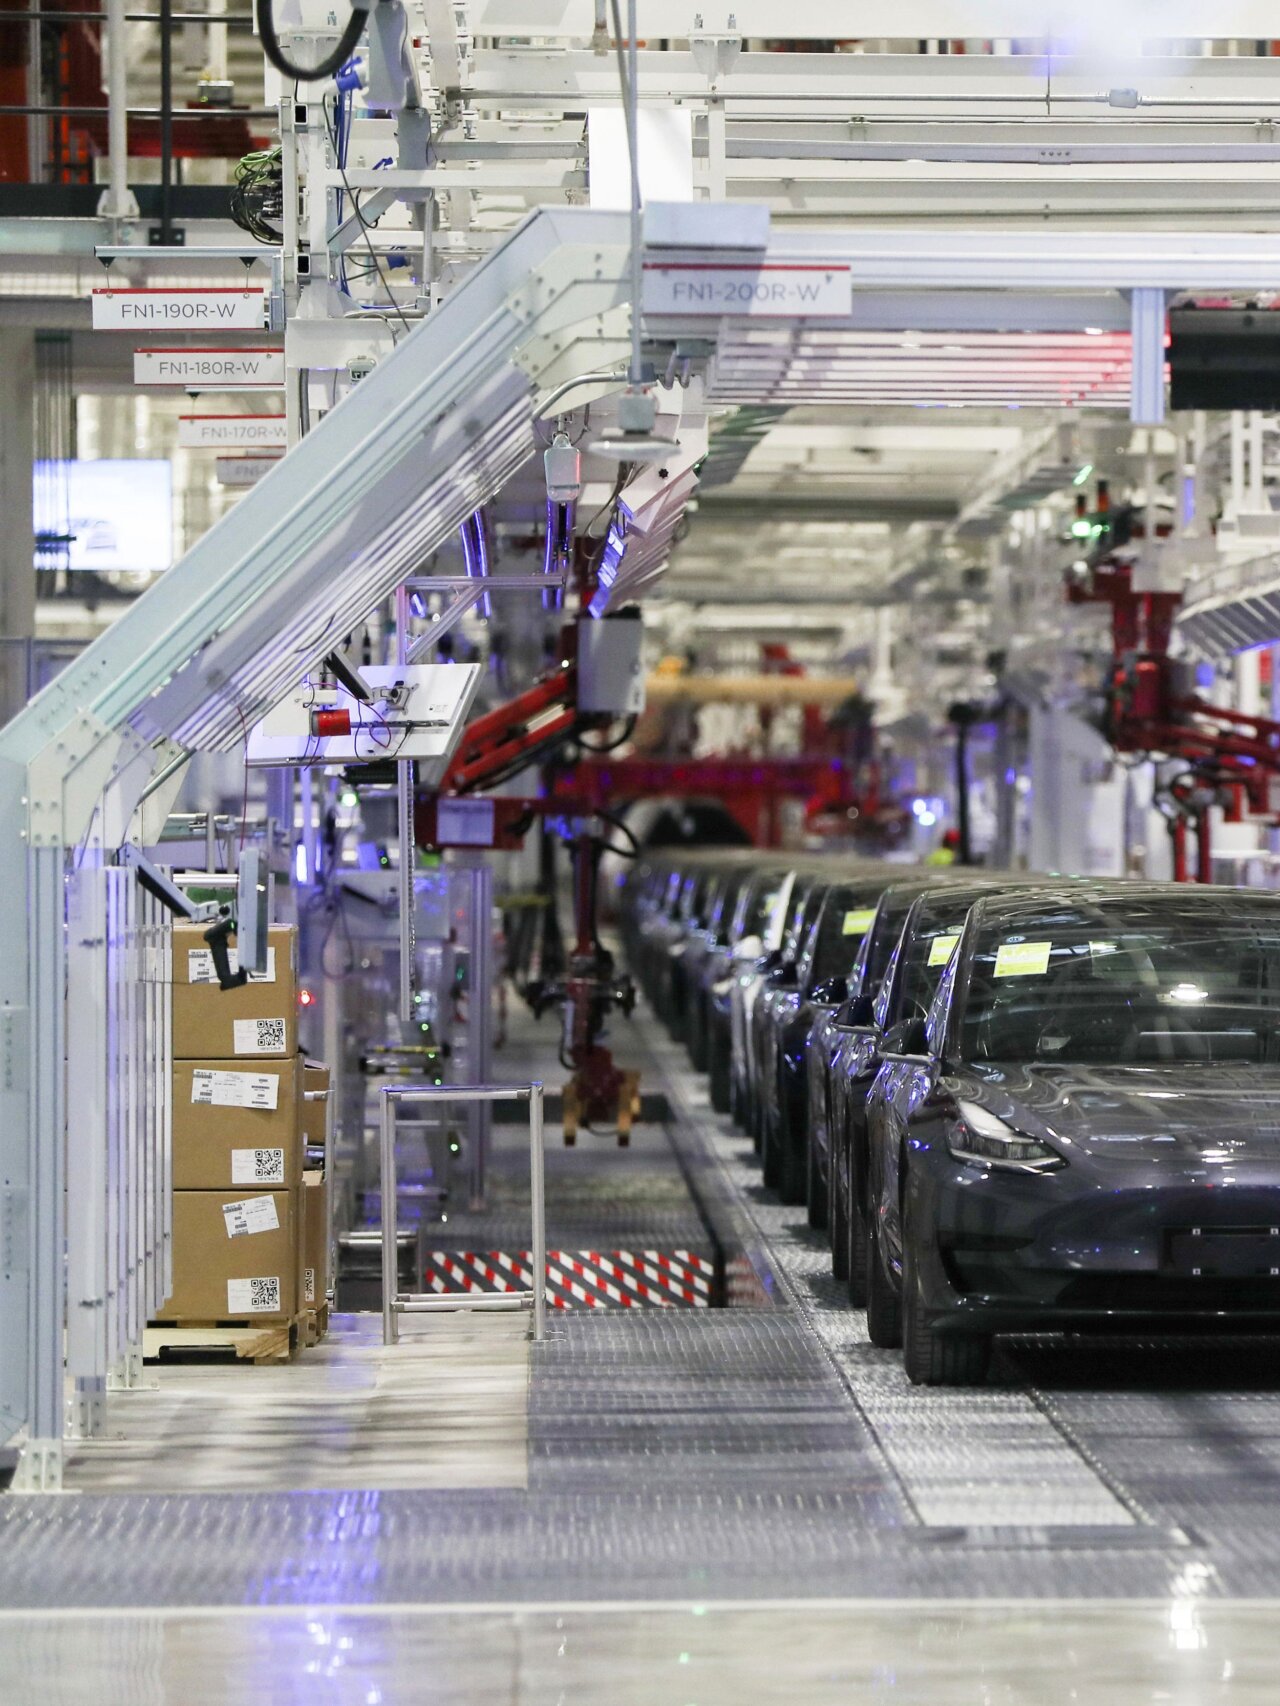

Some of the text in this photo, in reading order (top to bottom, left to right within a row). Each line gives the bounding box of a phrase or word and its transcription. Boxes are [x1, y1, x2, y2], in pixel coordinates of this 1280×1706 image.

[672, 282, 820, 301] FN1-200R-W
[121, 303, 236, 318] FN1-190R-W
[159, 361, 259, 375] FN1-180R-W
[201, 427, 287, 439] FN1-170R-W
